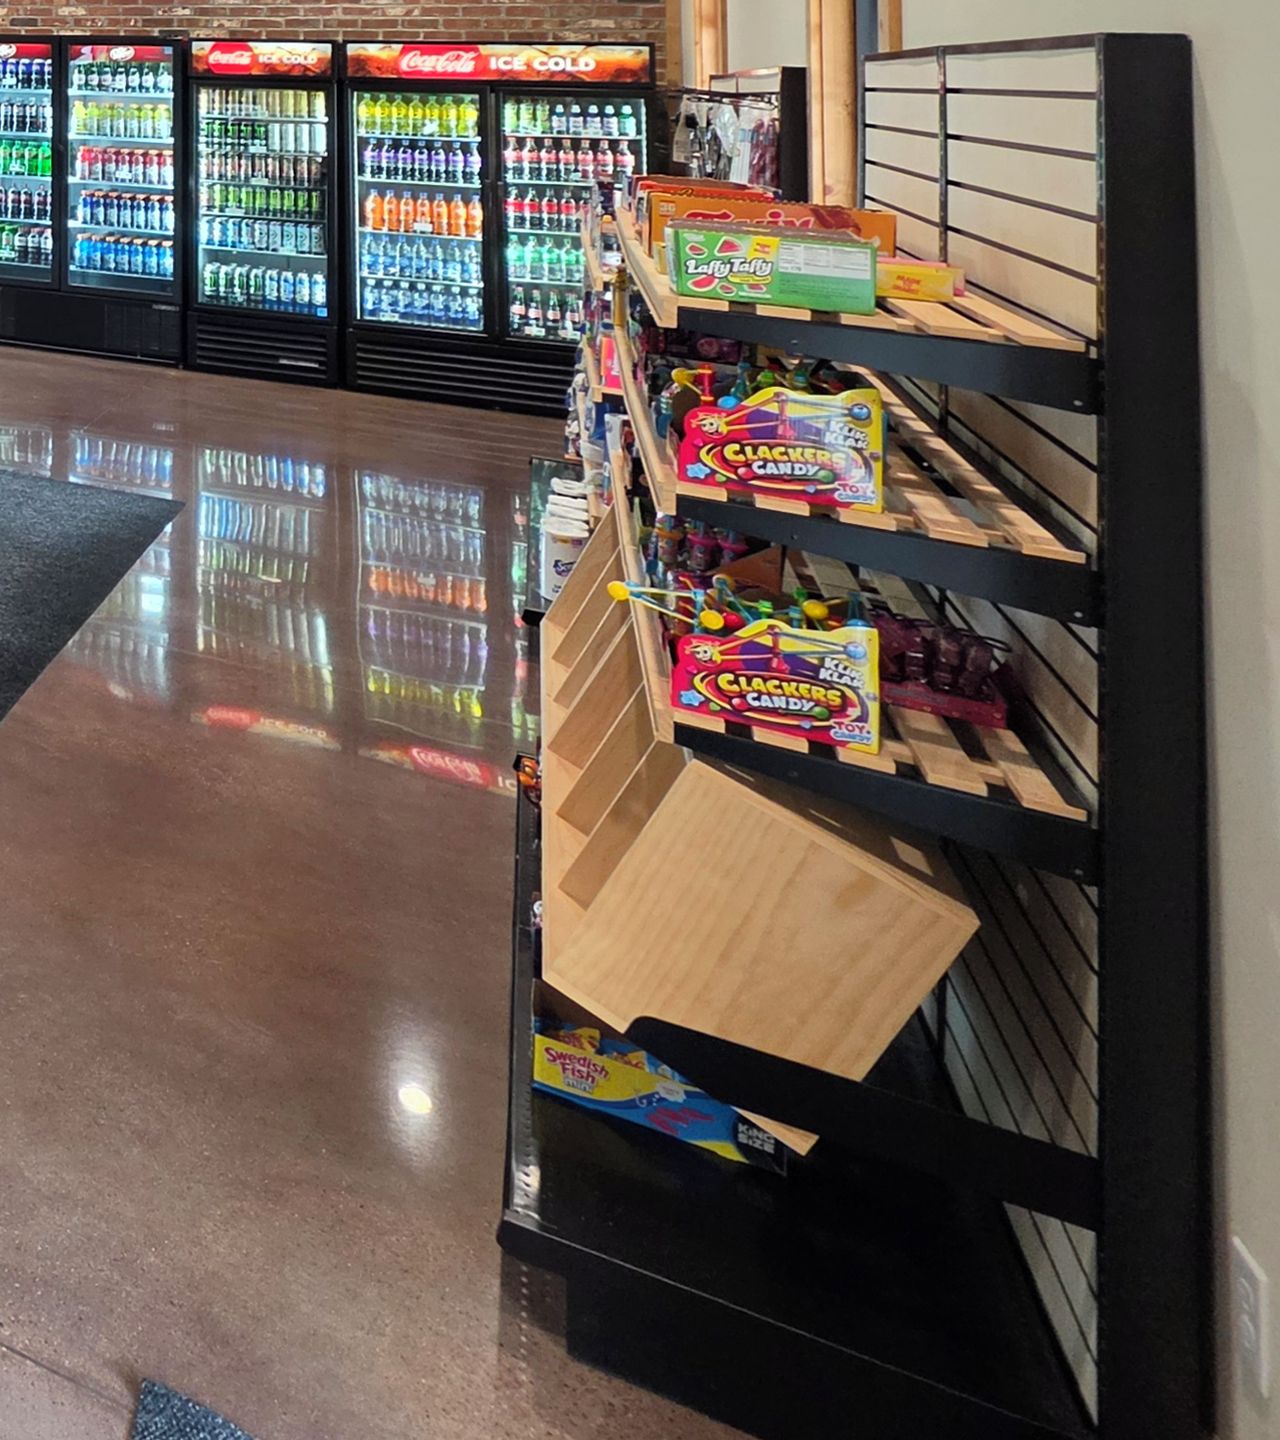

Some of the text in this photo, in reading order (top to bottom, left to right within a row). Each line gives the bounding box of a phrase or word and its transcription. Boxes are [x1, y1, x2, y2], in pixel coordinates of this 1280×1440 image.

[258, 53, 280, 64] ICE
[282, 53, 318, 64] COLD
[490, 56, 528, 71] ICE
[533, 57, 597, 72] COLD
[685, 258, 731, 278] Laffy
[730, 257, 773, 277] Taffy
[824, 432, 869, 450] KLAK
[829, 420, 868, 441] KLIK
[723, 443, 847, 468] CLACKERS
[752, 461, 820, 476] CANDY
[819, 668, 865, 689] KLAK
[824, 658, 864, 679] KLIK
[717, 673, 842, 705] CLACKERS
[745, 693, 817, 711] CANDY
[834, 721, 867, 734] TOY
[544, 1046, 610, 1079] Swedish
[560, 1061, 598, 1084] Fish
